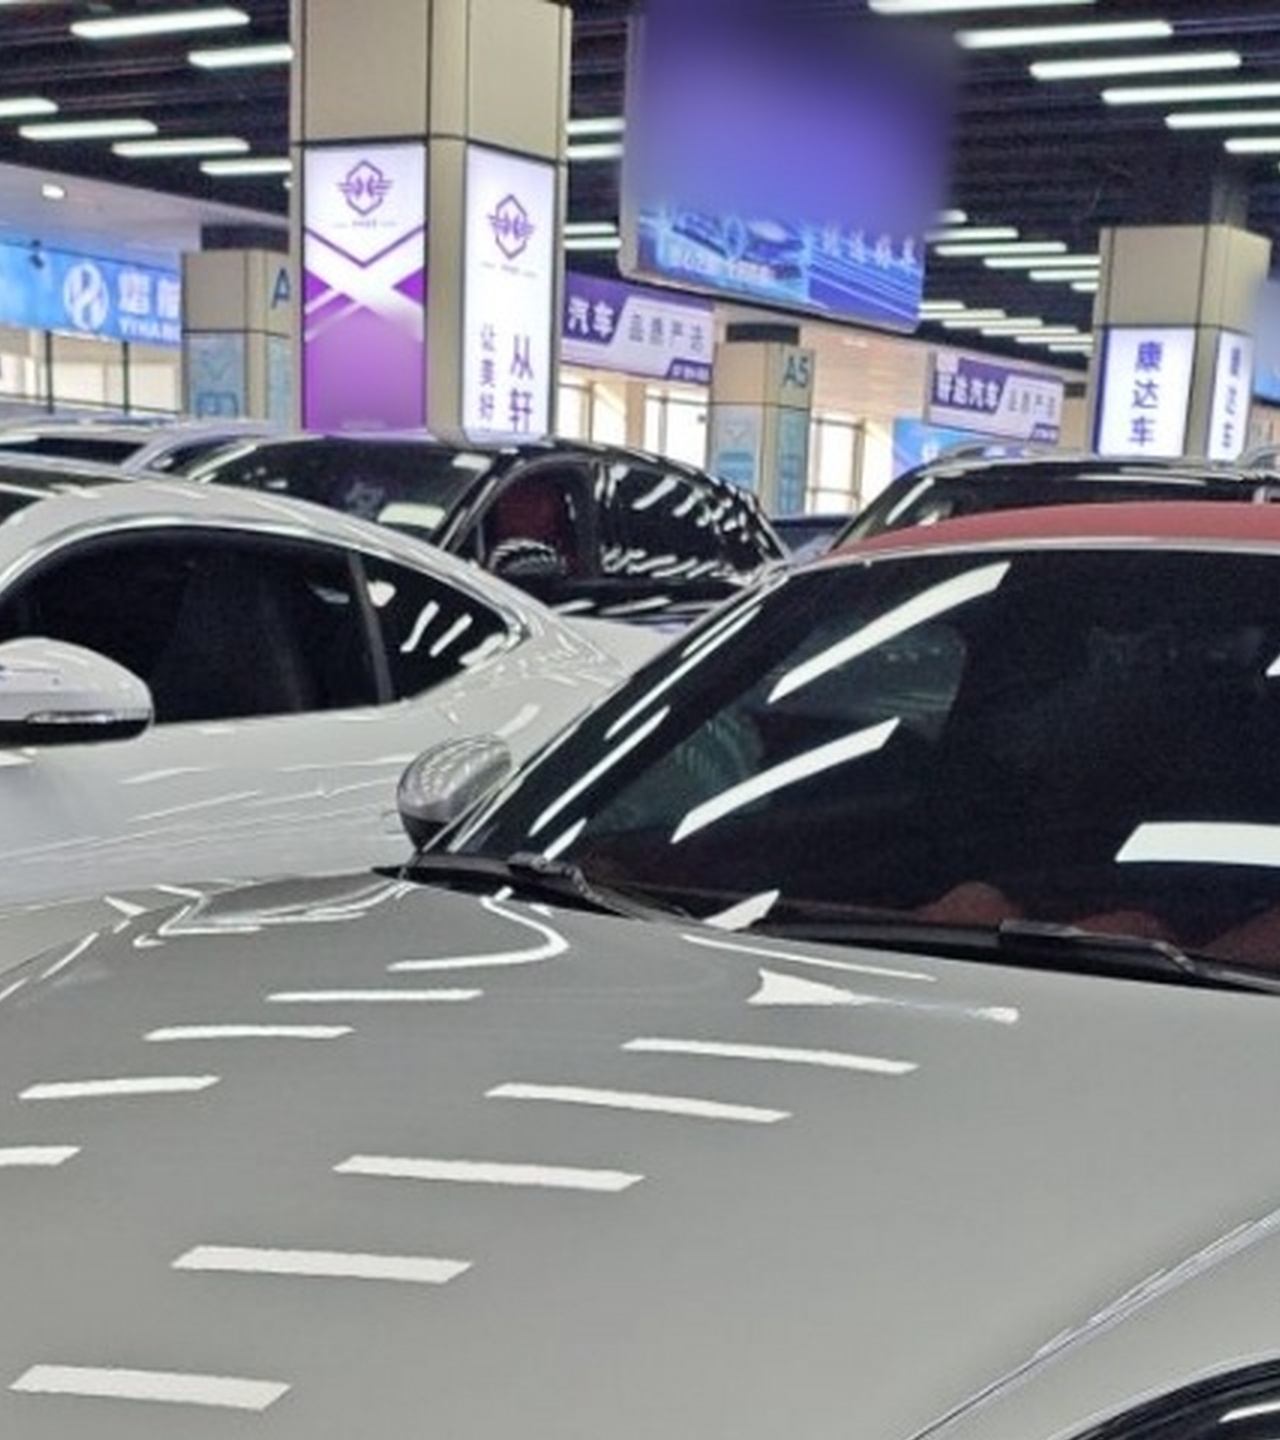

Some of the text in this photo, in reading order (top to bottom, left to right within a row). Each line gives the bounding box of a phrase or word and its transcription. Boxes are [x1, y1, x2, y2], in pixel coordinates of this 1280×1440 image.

[480, 322, 496, 434] 让美好
[1128, 340, 1163, 446] 康达车
